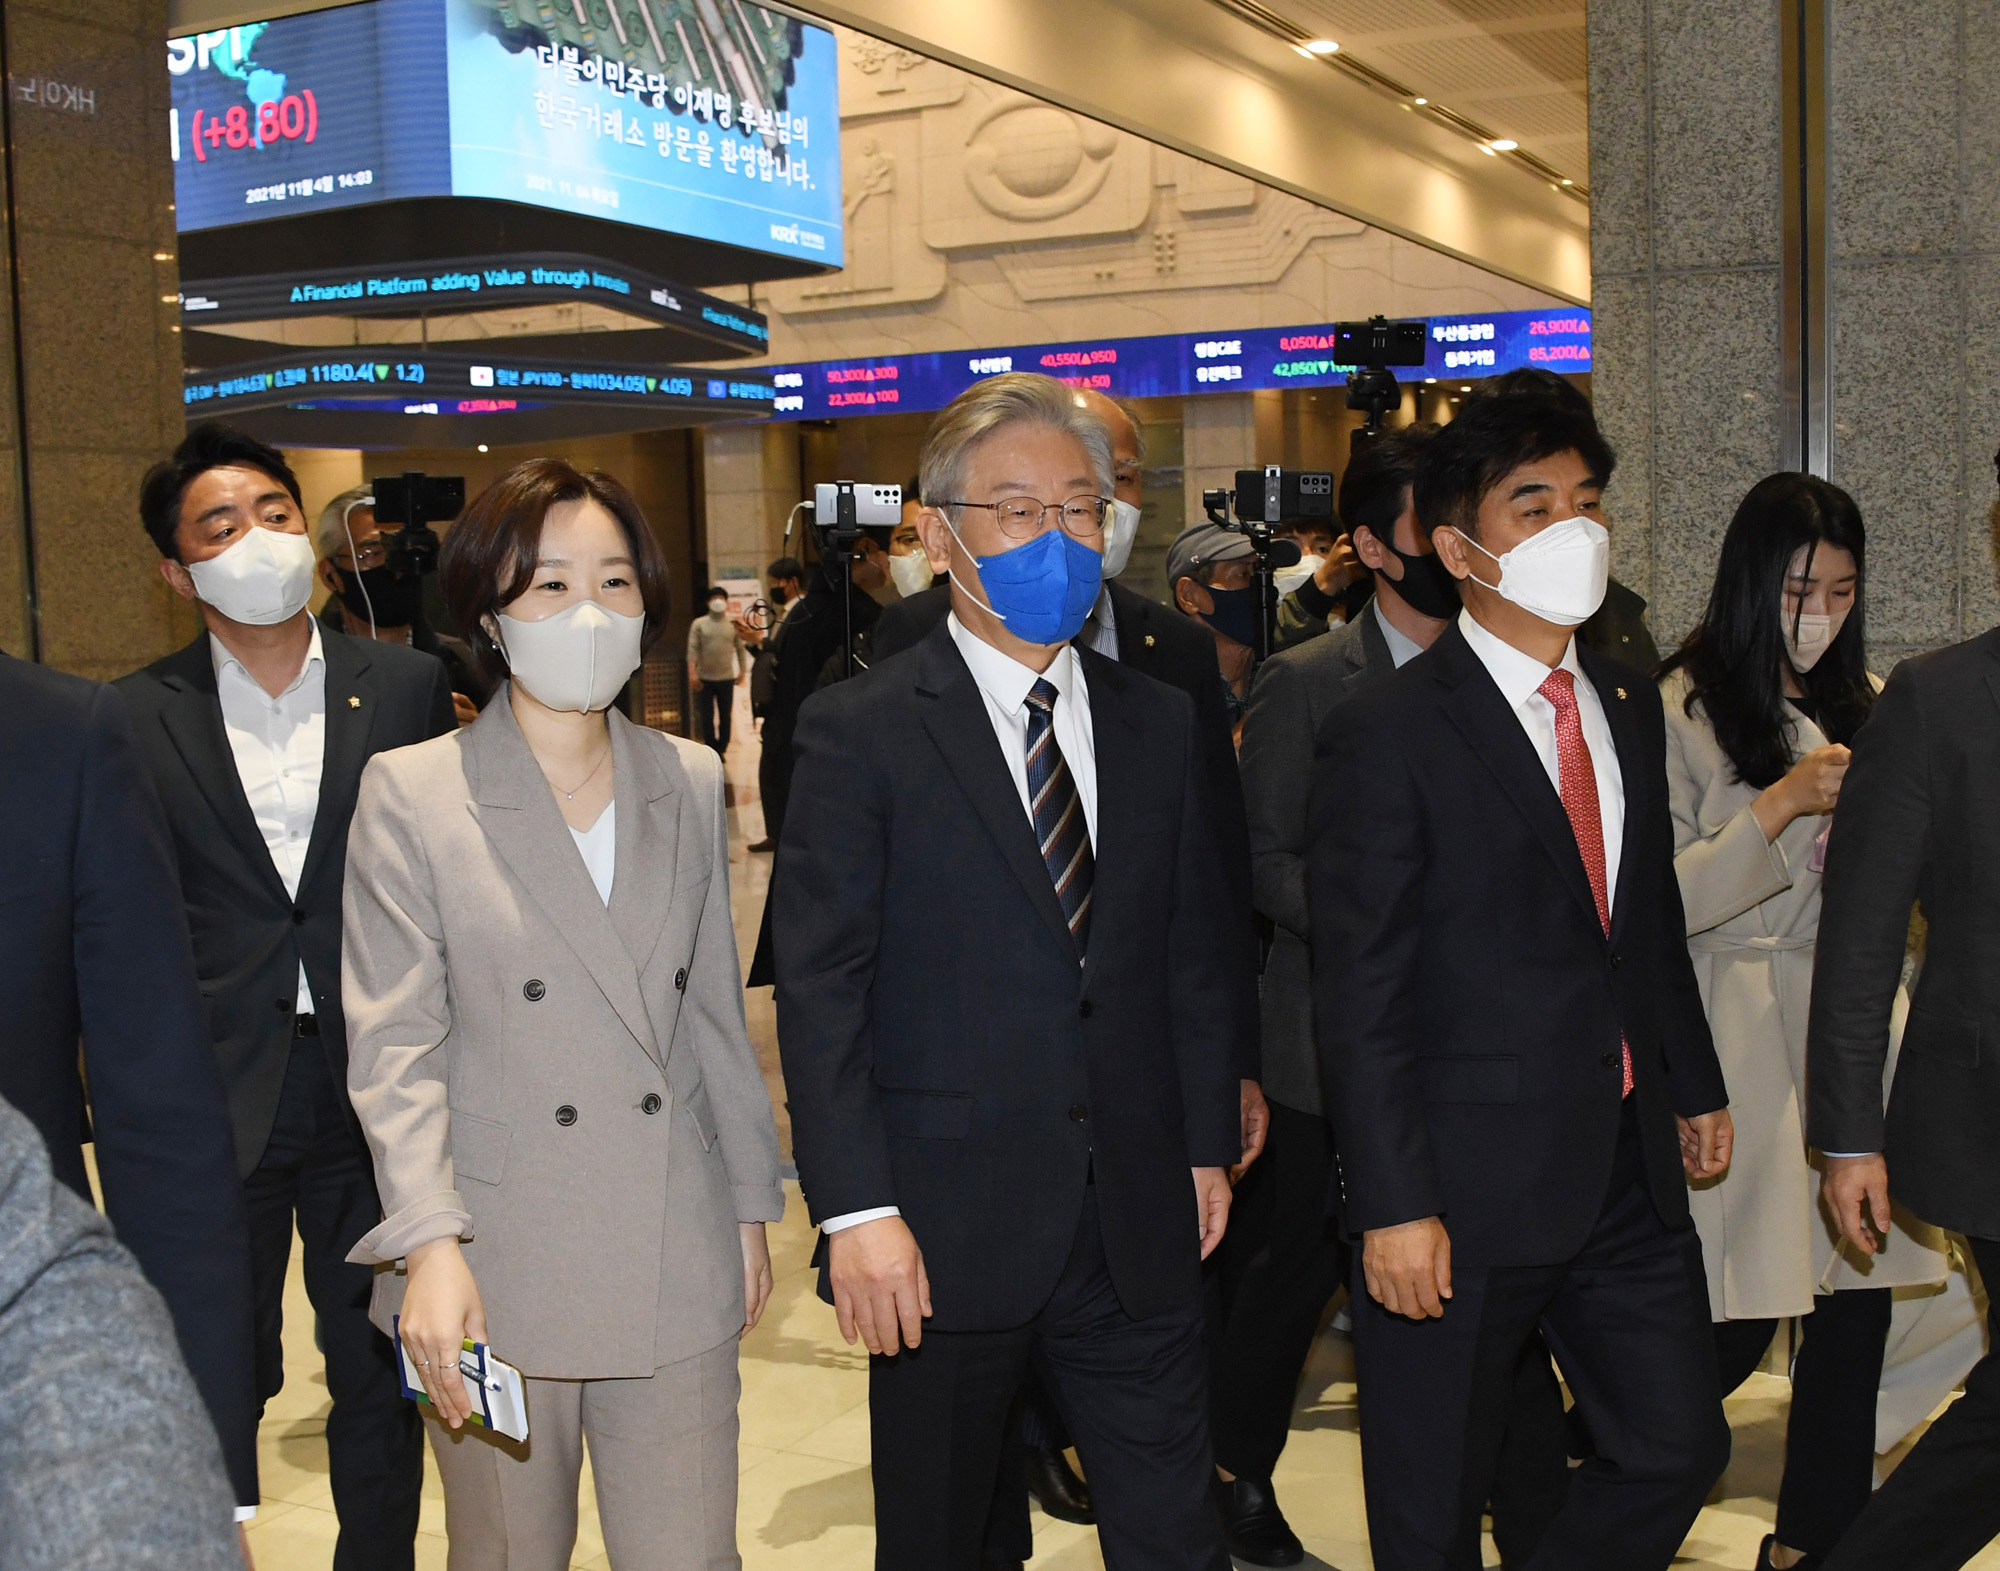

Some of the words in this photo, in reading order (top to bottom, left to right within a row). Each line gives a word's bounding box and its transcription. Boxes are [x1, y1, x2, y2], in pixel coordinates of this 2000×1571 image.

[192, 89, 318, 163] (+8.80)
[537, 41, 669, 110] 더불어민주당
[673, 82, 733, 129] 이재명
[738, 99, 810, 150] 후보님의
[533, 88, 648, 147] 한국거래소
[652, 119, 715, 168] 방문을
[719, 136, 817, 192] 환영합니다.
[245, 183, 287, 204] 2021년
[290, 287, 303, 302] A
[304, 281, 363, 300] Financial
[366, 277, 427, 297] Platform
[431, 273, 480, 292] adding
[484, 268, 526, 287] Value
[532, 267, 590, 289] through
